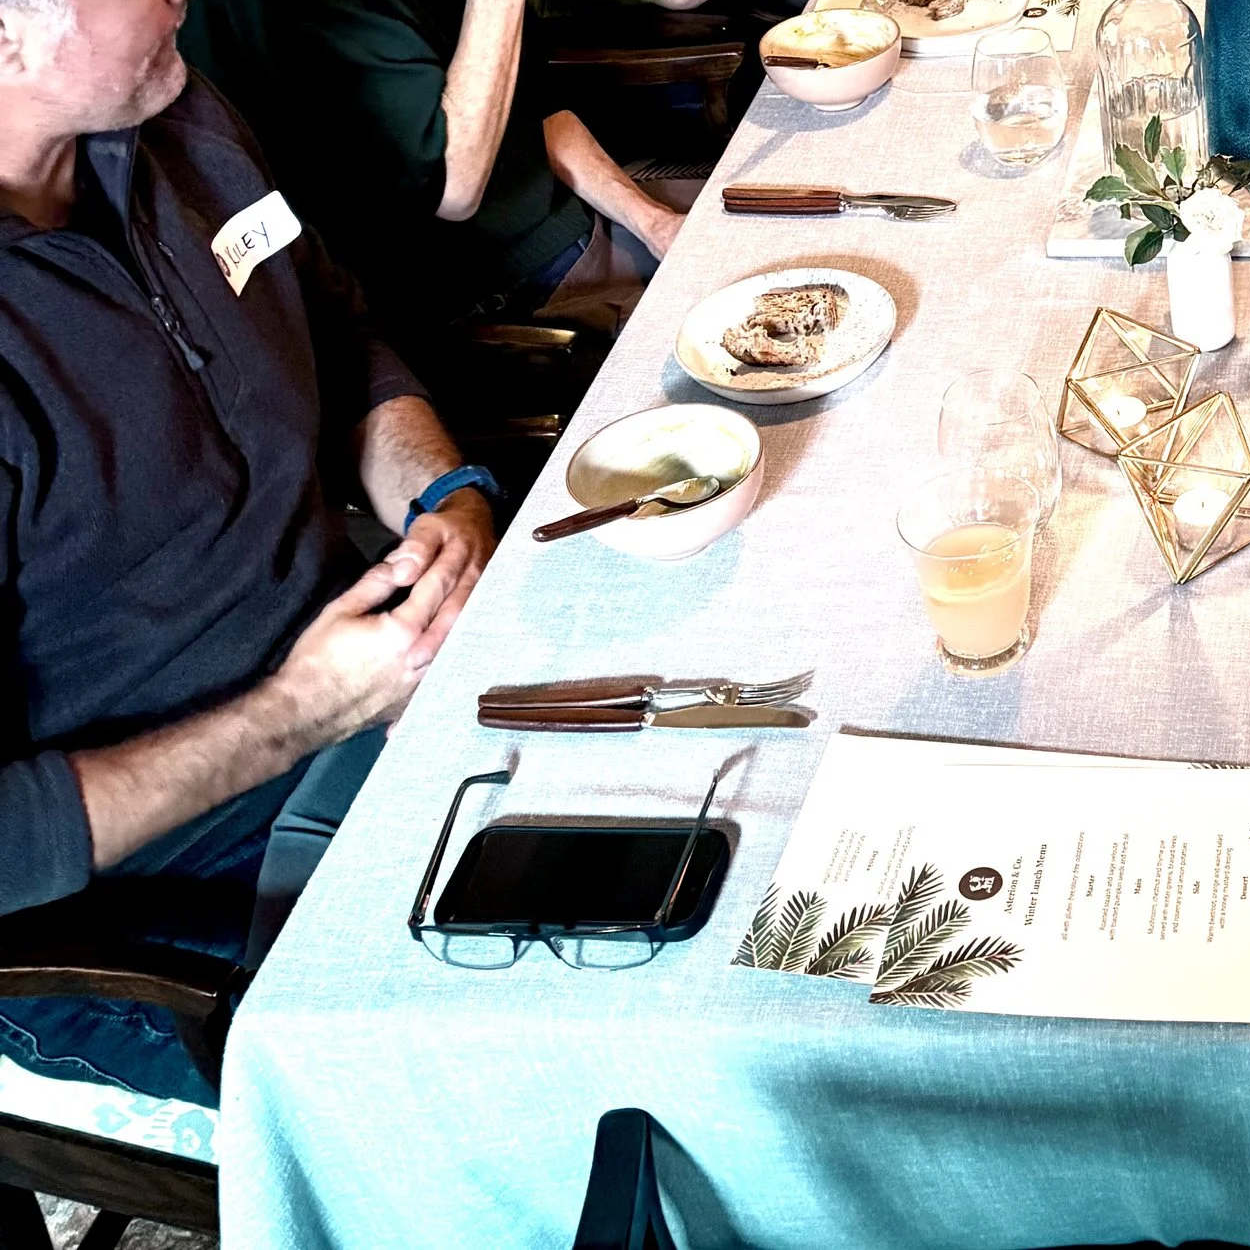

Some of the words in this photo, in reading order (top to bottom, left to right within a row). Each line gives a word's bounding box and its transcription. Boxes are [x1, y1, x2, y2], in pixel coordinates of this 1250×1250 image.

[1036, 844, 1047, 867] Menu
[1004, 880, 1018, 914] Asterion
[1013, 856, 1022, 869] Co.
[1030, 870, 1042, 894] Lunch
[1086, 875, 1094, 897] Starter
[1024, 897, 1037, 925] Winter
